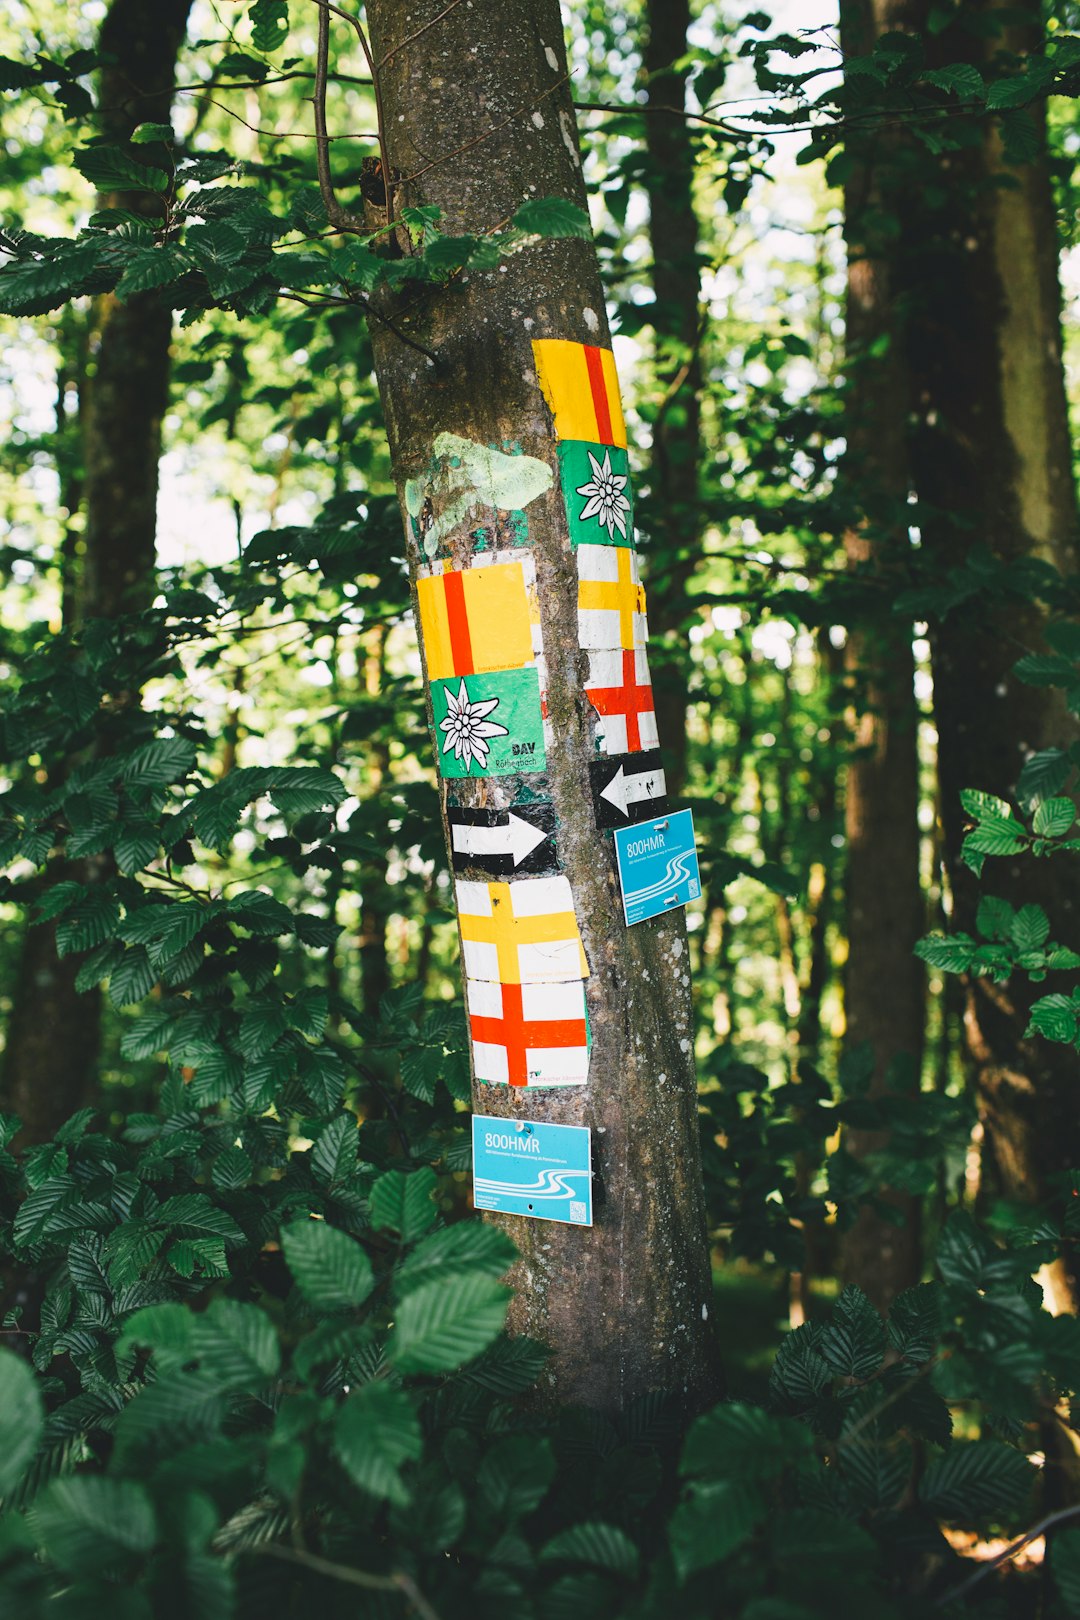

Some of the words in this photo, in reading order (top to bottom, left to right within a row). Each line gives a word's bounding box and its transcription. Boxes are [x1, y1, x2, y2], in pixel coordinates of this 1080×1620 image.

[512, 742, 535, 756] DAV
[626, 833, 666, 858] 800HMR
[484, 1132, 541, 1154] 800HMR
